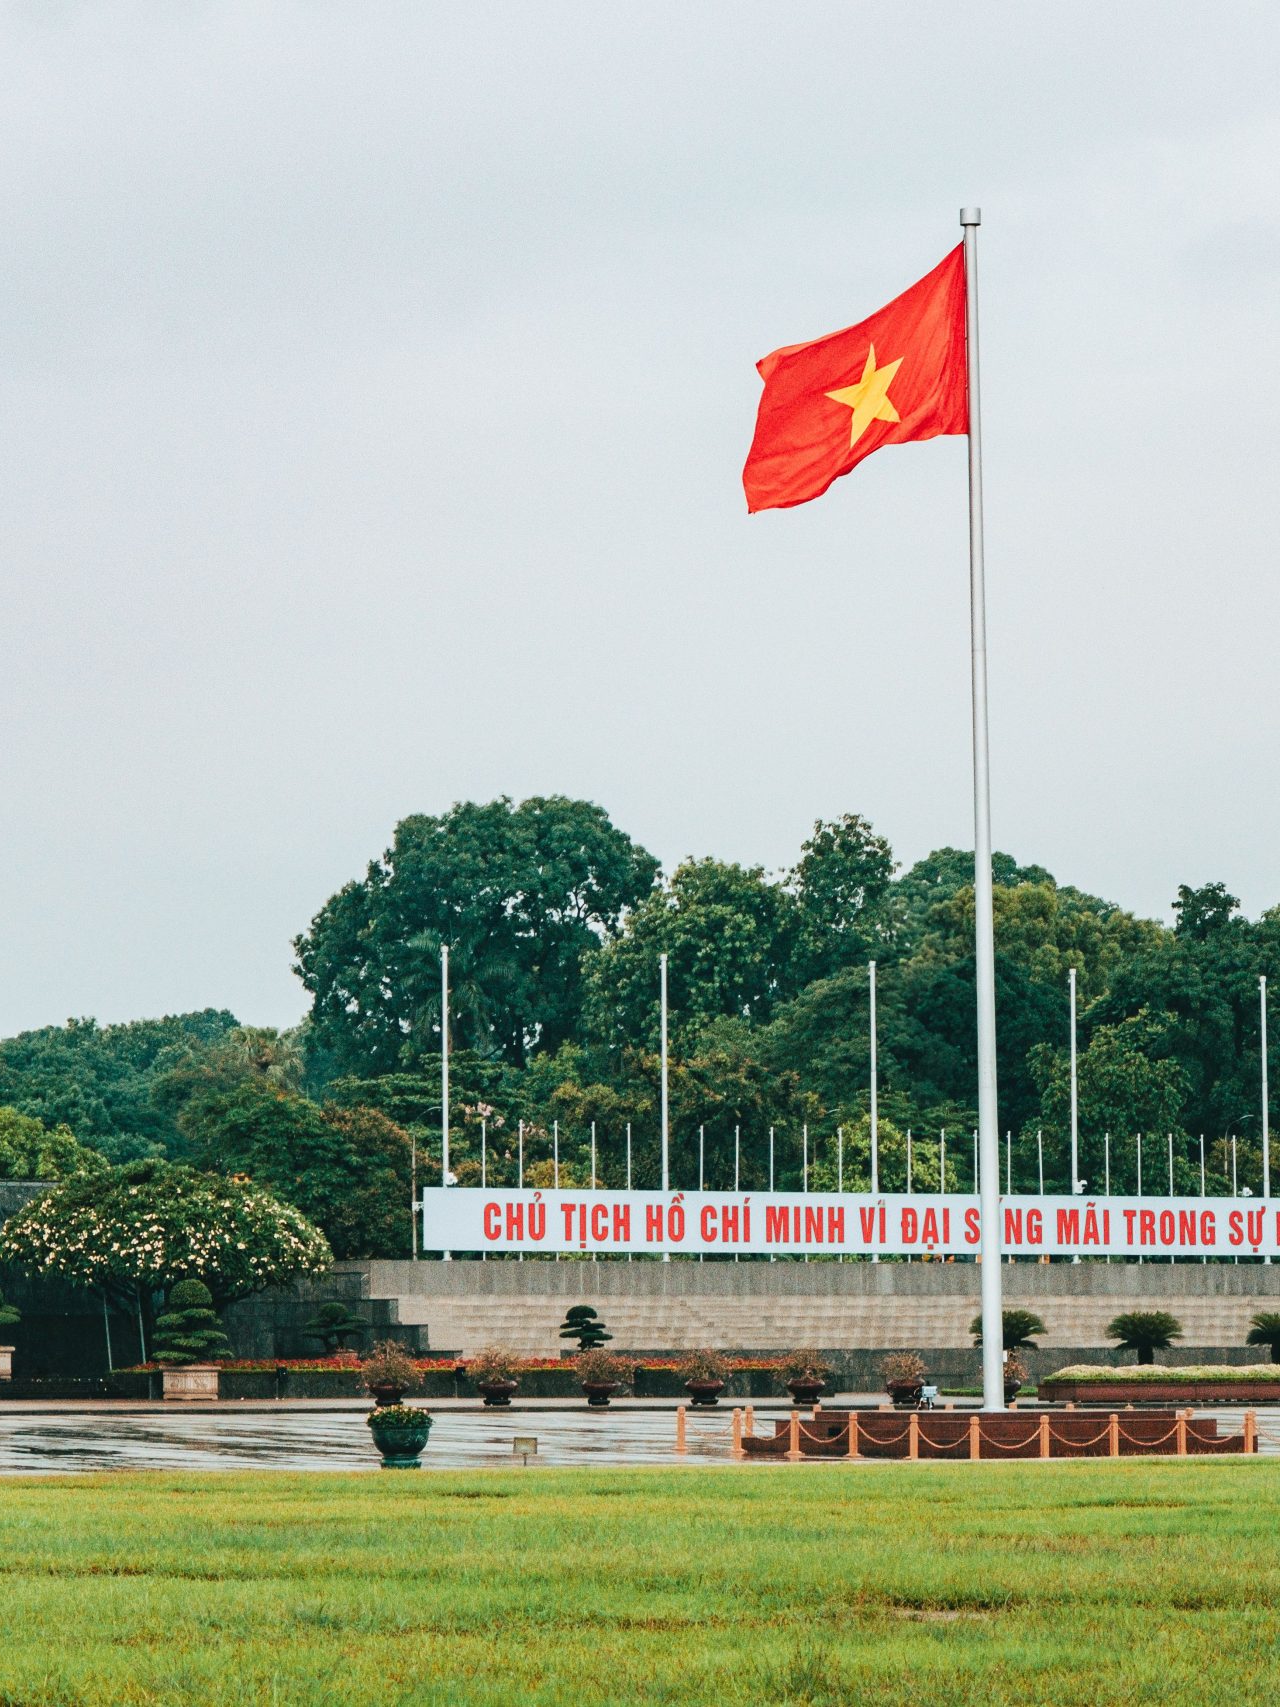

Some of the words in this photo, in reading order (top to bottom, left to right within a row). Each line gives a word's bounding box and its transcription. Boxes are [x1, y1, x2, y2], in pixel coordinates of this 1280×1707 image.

[483, 1191, 546, 1242] CHỦ
[560, 1203, 631, 1249] TỊCH
[645, 1193, 685, 1243] HỒ
[700, 1197, 751, 1243] CHÍ
[765, 1205, 845, 1244] MINH
[900, 1207, 950, 1250] ĐẠI
[964, 1197, 1043, 1245] SNG
[1056, 1201, 1111, 1246] MÃI
[1122, 1209, 1216, 1246] TRONG
[1228, 1206, 1266, 1253] SỰ
